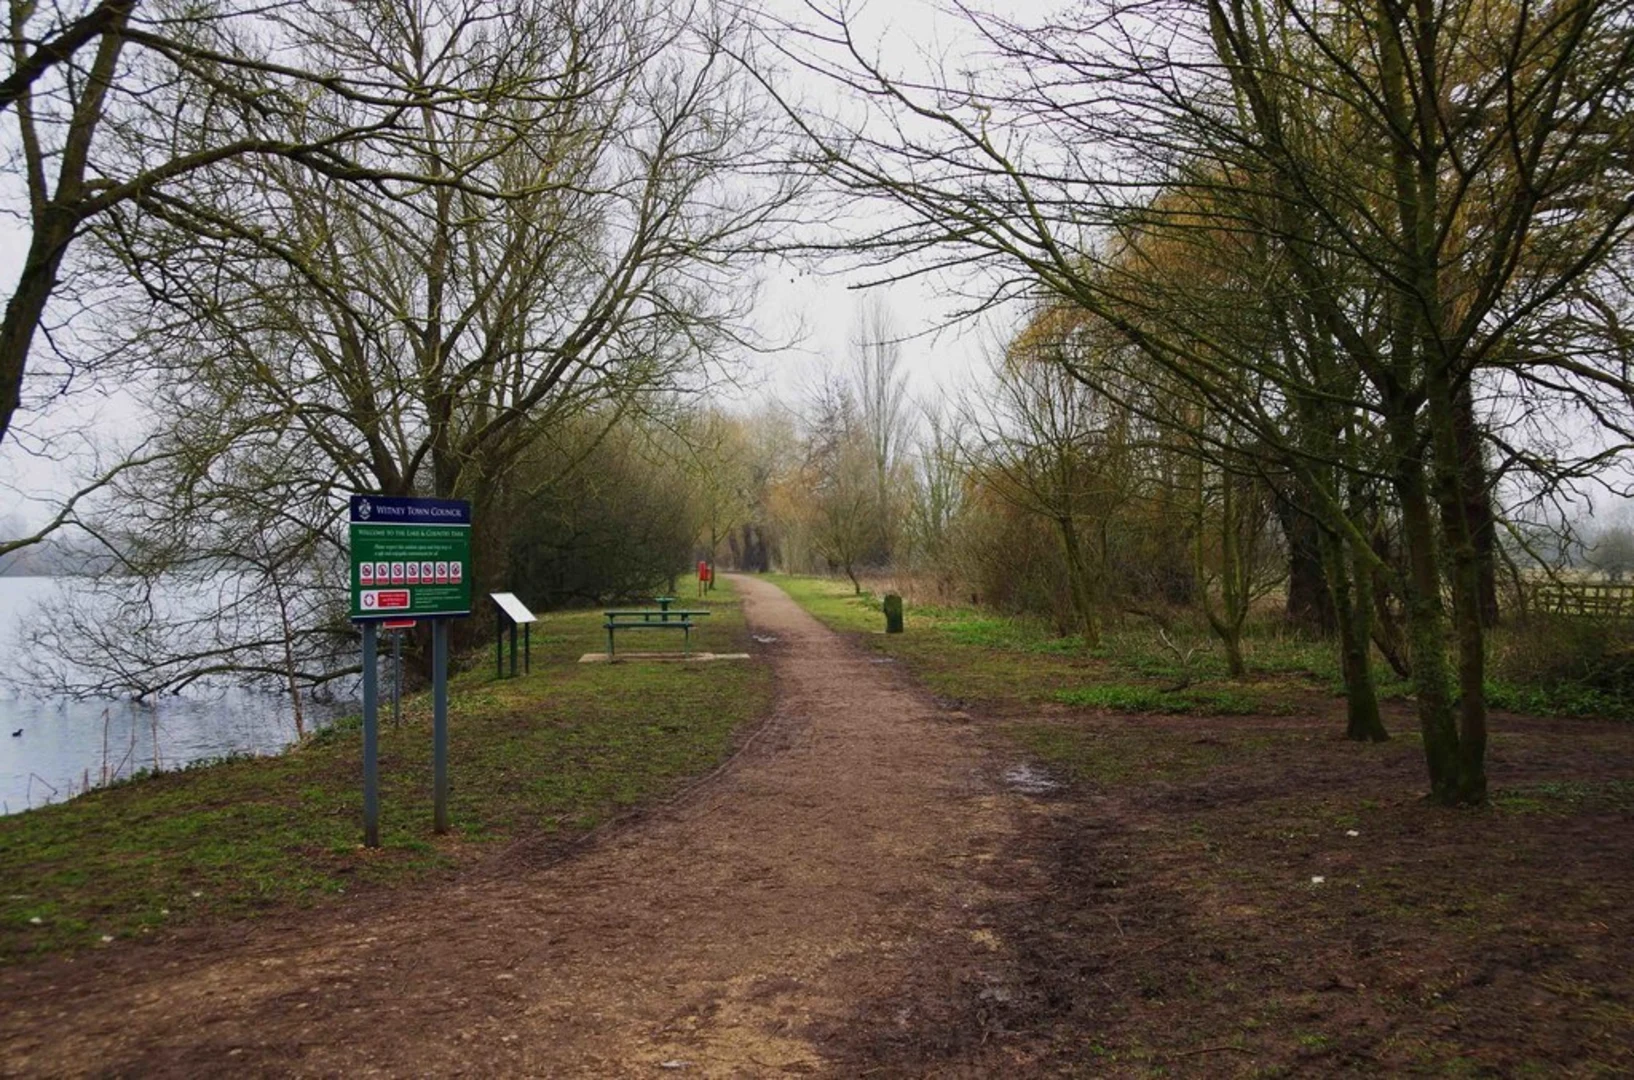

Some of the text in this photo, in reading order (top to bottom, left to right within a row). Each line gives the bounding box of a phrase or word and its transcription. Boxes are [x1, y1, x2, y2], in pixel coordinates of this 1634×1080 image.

[376, 505, 462, 517] WITNEY TOWN COUNCIL
